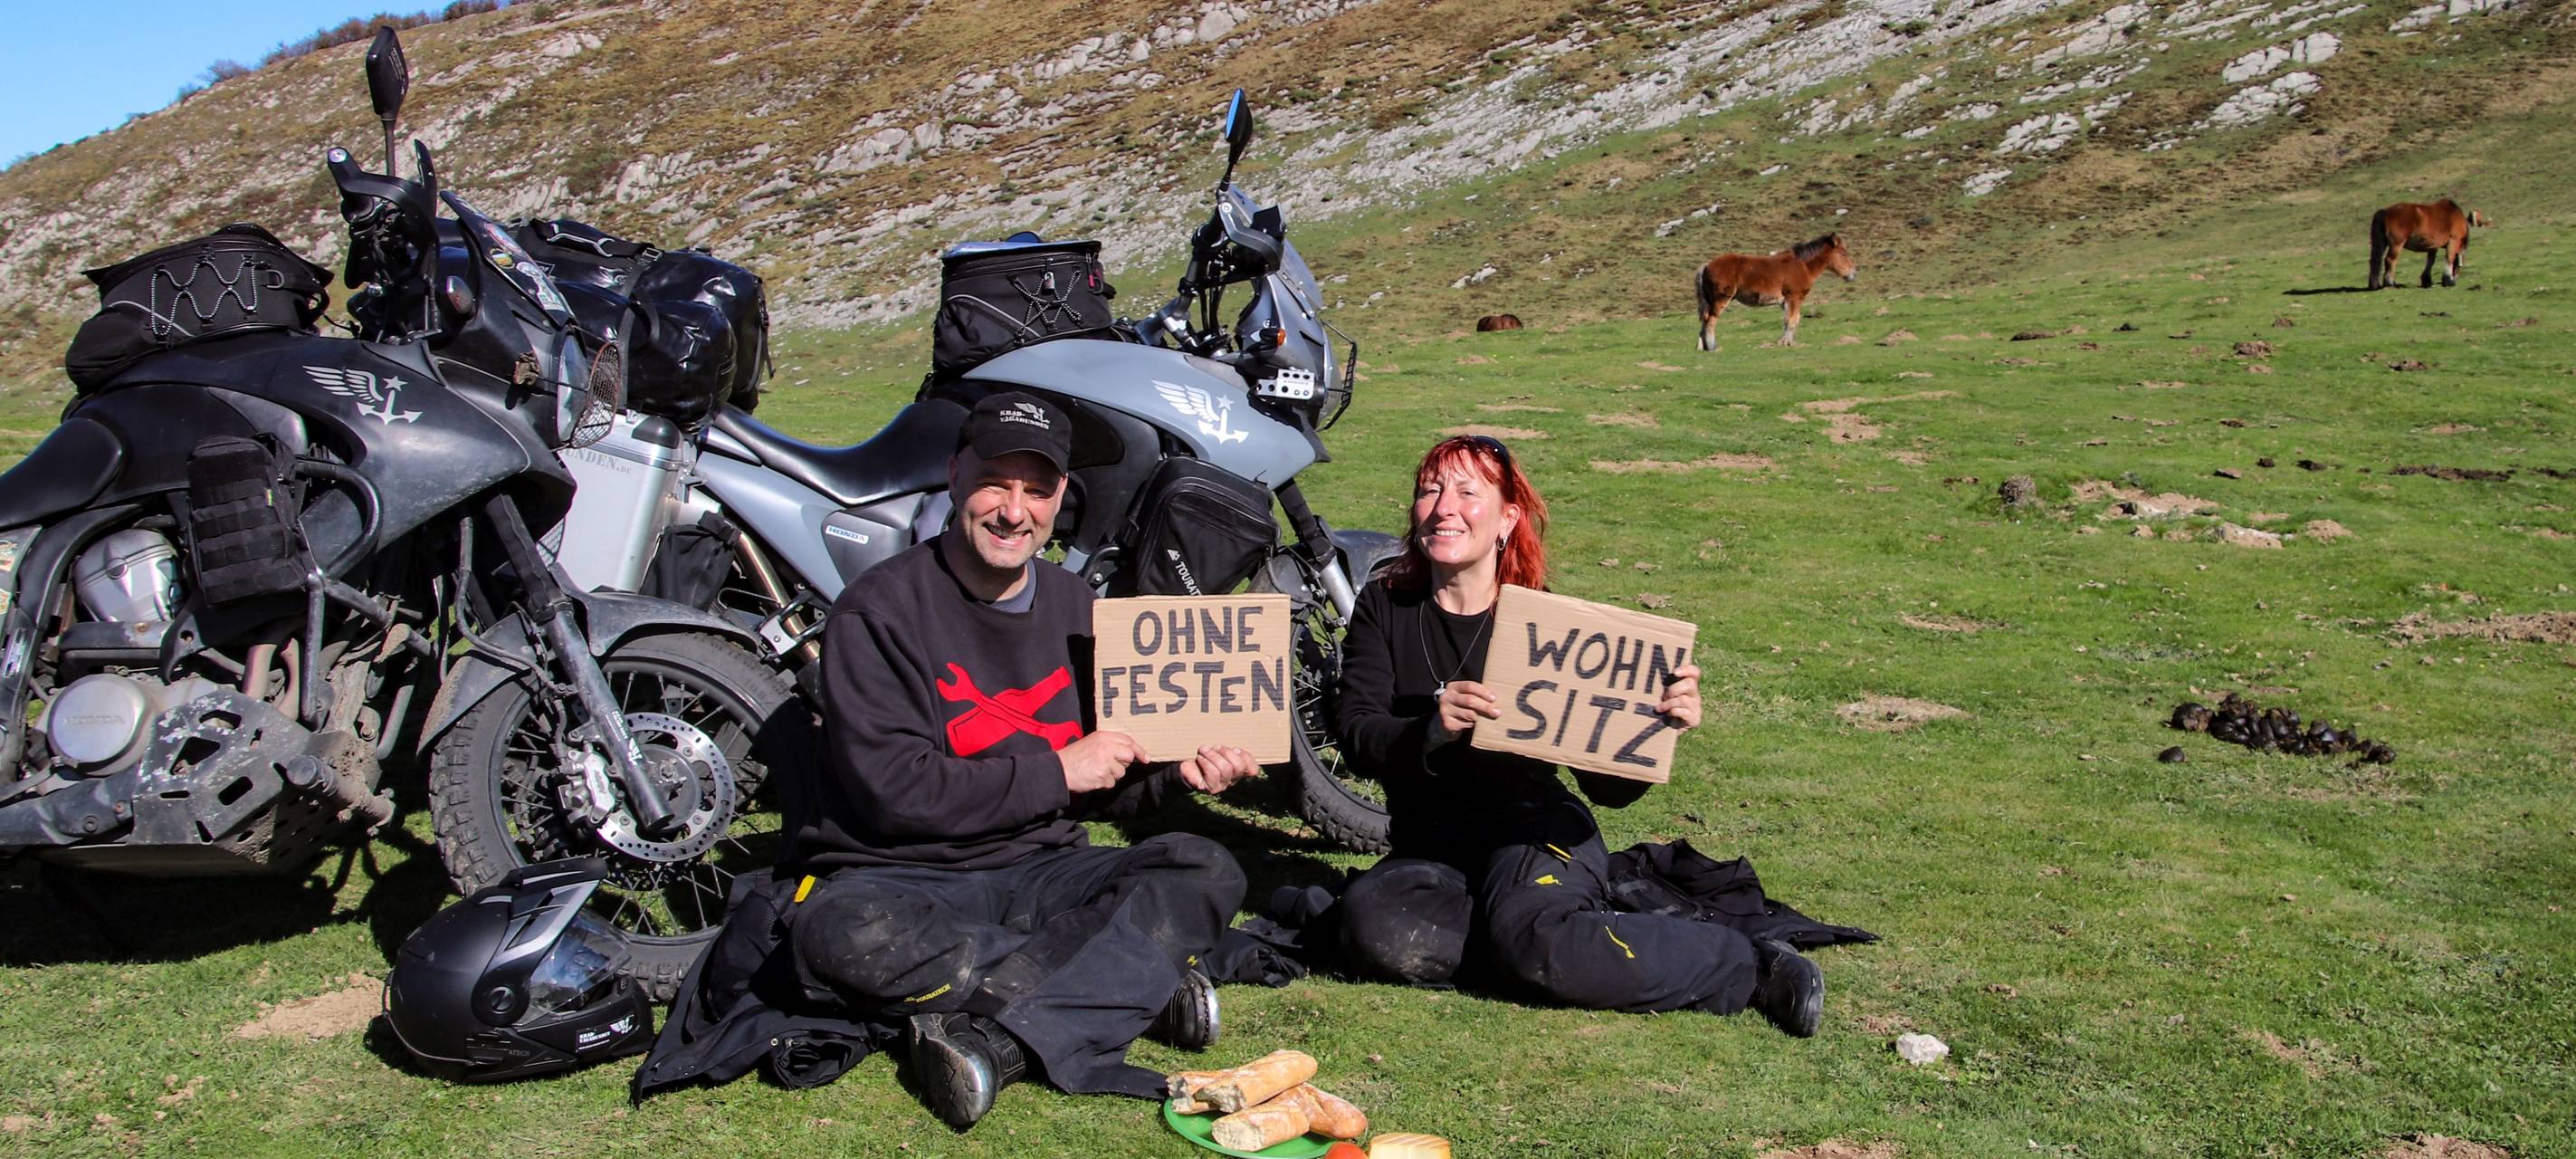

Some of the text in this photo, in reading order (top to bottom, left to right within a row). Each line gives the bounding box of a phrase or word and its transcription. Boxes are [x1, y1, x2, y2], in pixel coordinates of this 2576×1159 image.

[828, 527, 866, 542] HONDA
[1132, 606, 1264, 656] OHNE
[1526, 621, 1686, 694] WOHN
[1101, 656, 1285, 719] FESTEN
[1505, 679, 1668, 768] SITZ
